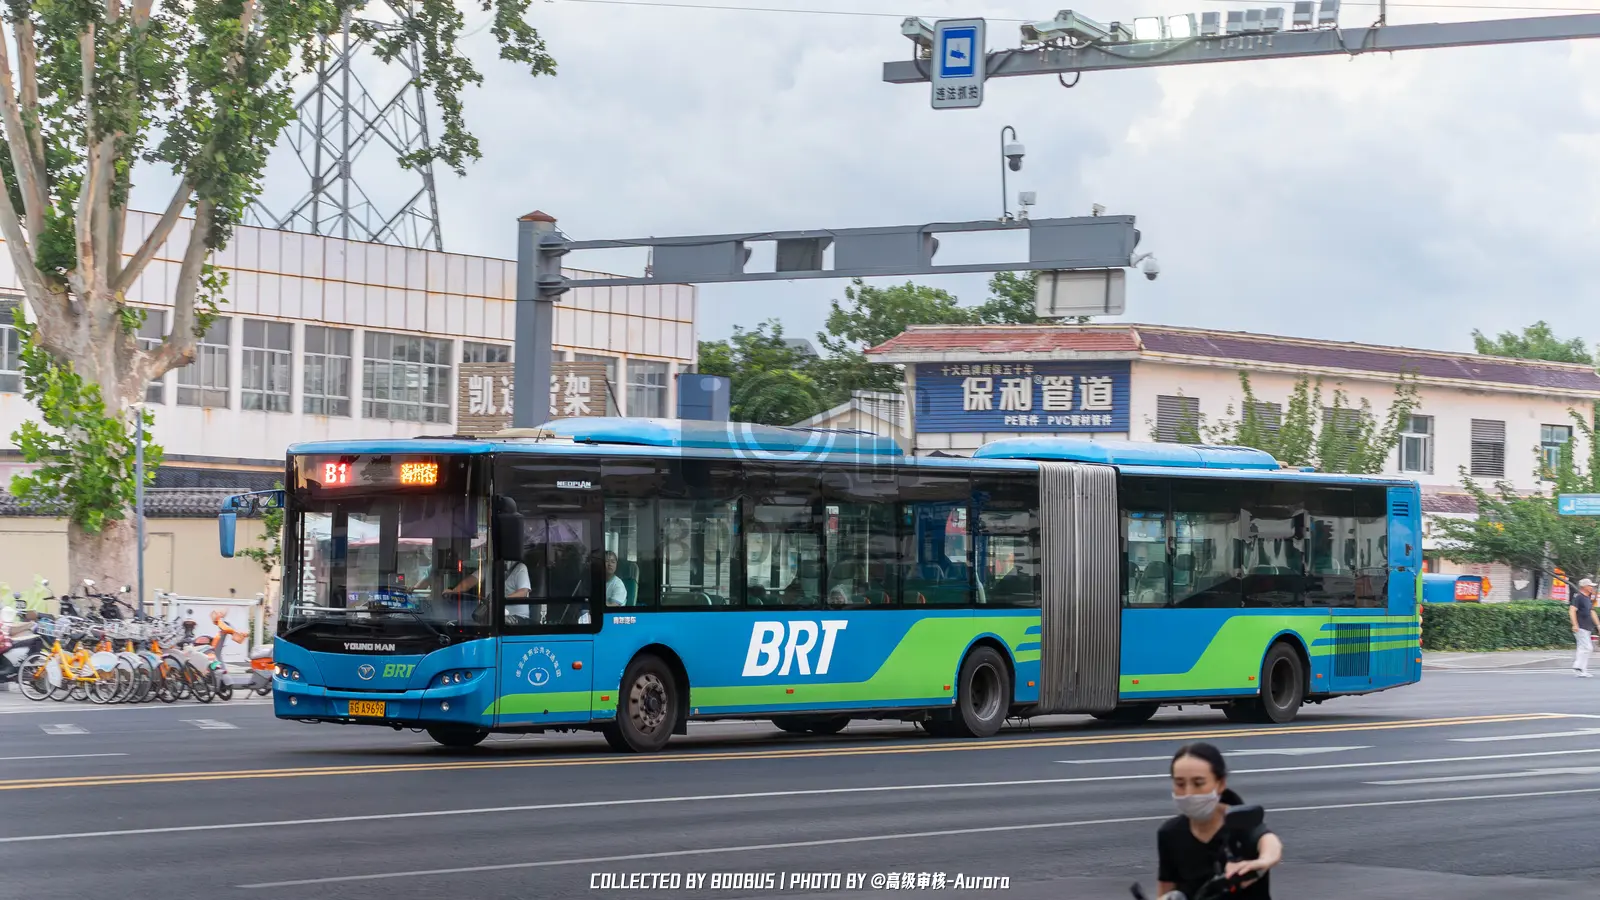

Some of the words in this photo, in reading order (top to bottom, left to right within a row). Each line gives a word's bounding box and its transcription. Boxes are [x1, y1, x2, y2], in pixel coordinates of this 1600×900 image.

[1004, 414, 1040, 426] PE管件
[325, 463, 346, 483] B1
[344, 642, 374, 651] YOUNG
[374, 643, 396, 652] MAN
[741, 620, 849, 677] BRT
[382, 663, 416, 678] BRT
